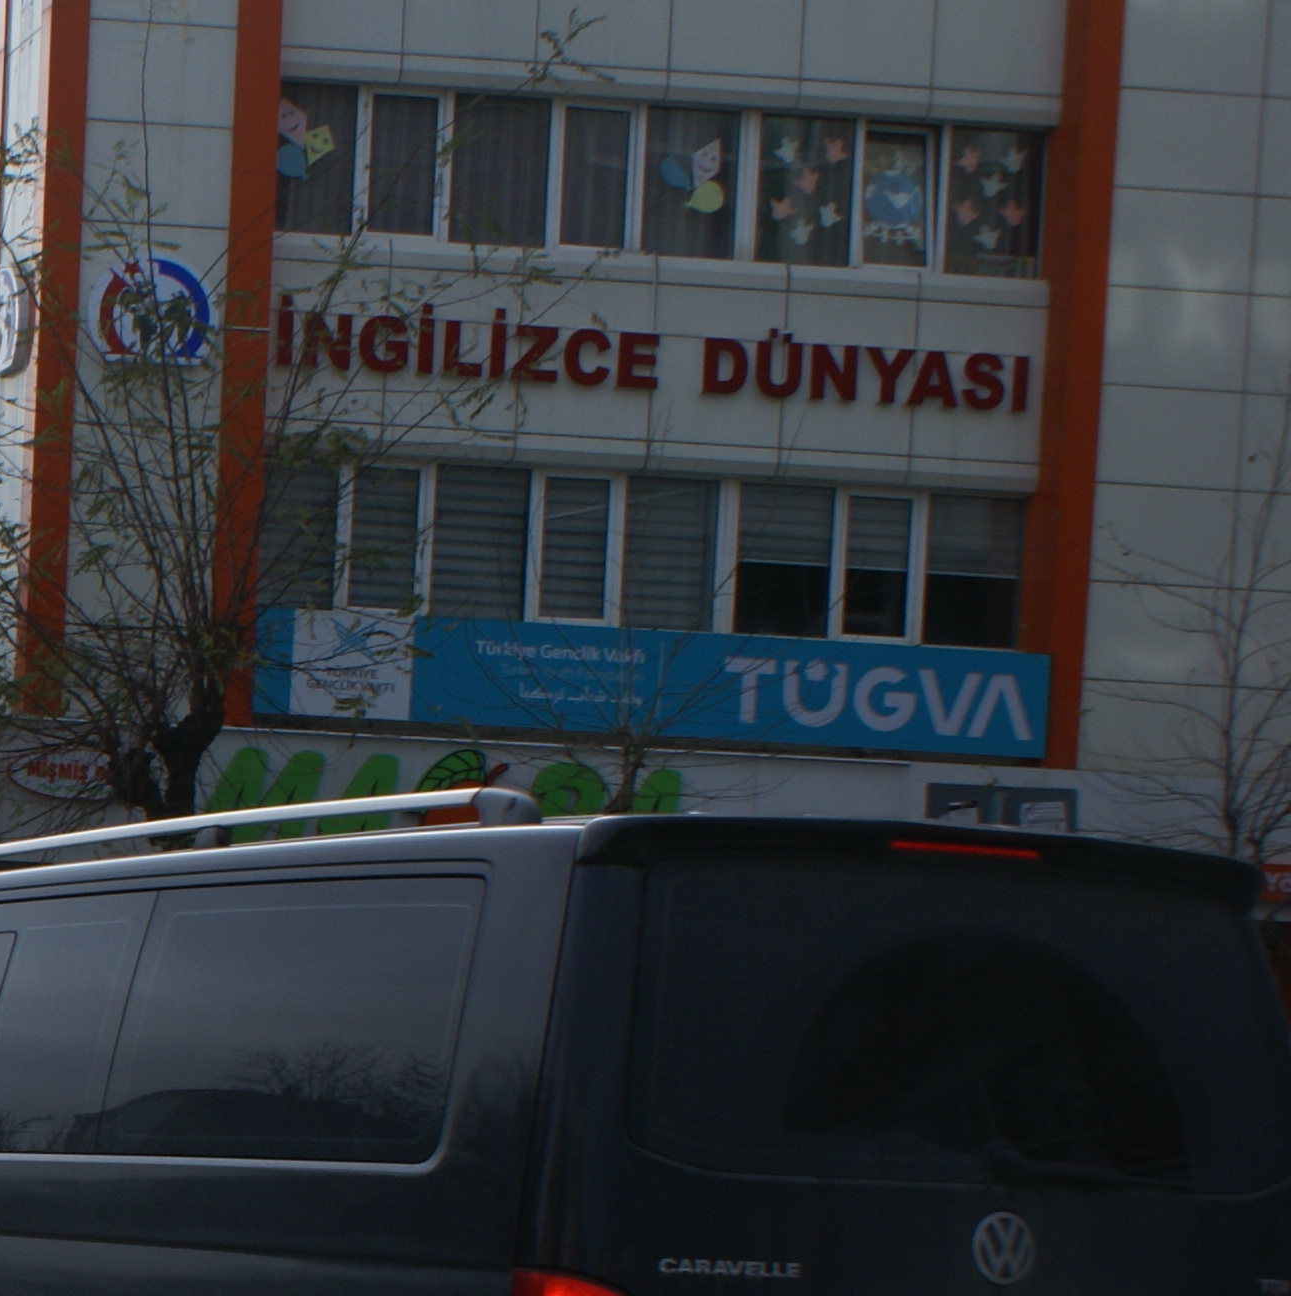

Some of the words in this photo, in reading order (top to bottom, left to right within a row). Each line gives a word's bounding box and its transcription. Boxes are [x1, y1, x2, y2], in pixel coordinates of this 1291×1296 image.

[276, 295, 660, 390] İNGİLİZCE
[700, 328, 1030, 413] DÜNYASI
[724, 656, 1033, 741] TÜGVA
[658, 1257, 802, 1279] CARAVELLE
